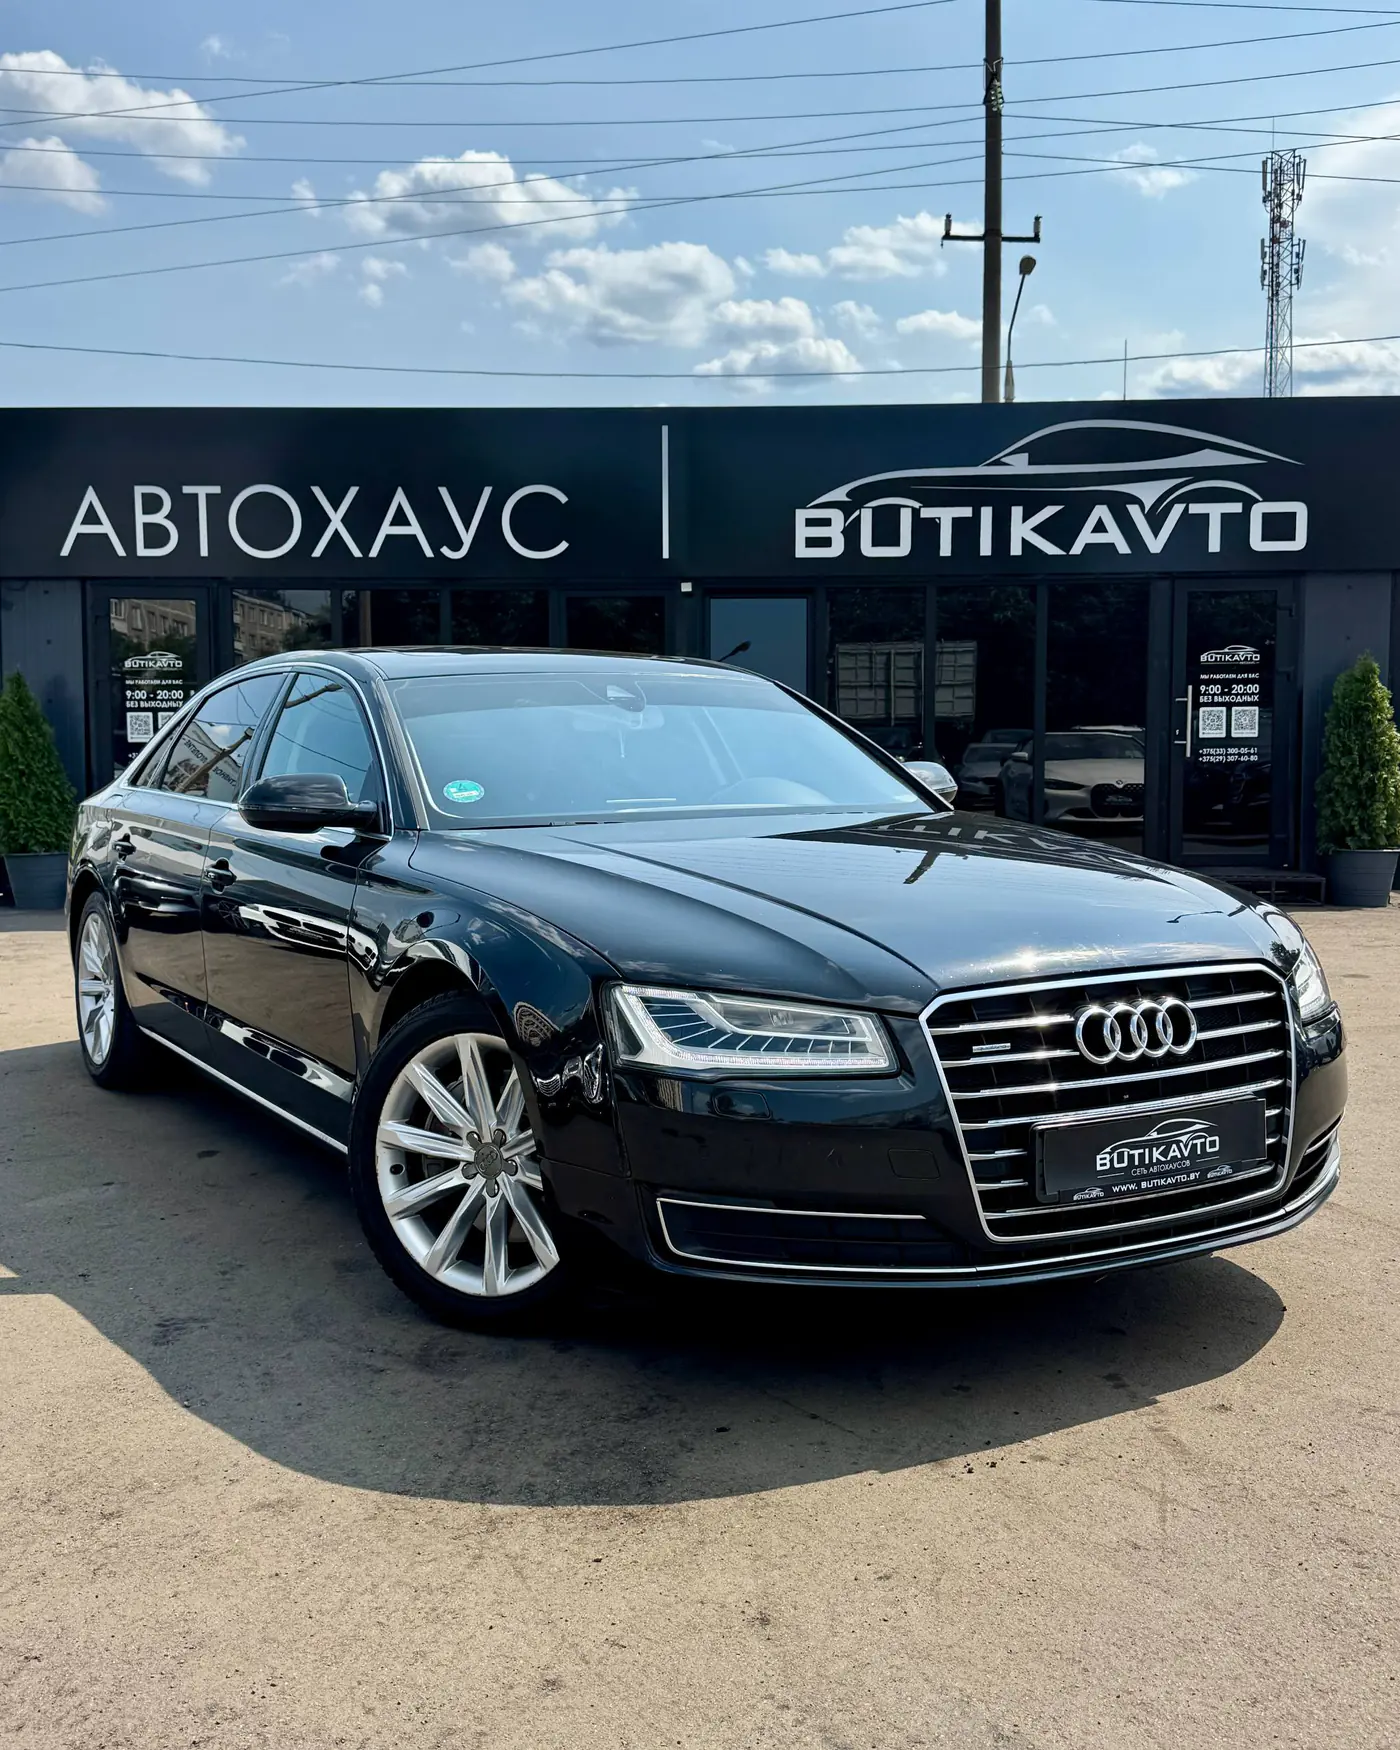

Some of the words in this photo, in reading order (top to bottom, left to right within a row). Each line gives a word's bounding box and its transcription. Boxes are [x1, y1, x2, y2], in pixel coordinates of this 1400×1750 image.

[60, 484, 570, 559] АВТОХАУС
[795, 501, 1308, 558] BUTIKAVTO
[1200, 654, 1260, 662] BUTIKAVTO
[124, 660, 183, 668] BUTIKAVTO
[1200, 684, 1221, 694] 9:00
[1231, 684, 1260, 694] 20:00
[125, 690, 147, 700] 9:00
[156, 690, 184, 700] 20:00
[1214, 695, 1260, 703] ВЫХОДНЫХ
[1198, 755, 1226, 763] +375(29)
[1096, 1136, 1220, 1170] BUTIKAVTO
[1131, 1168, 1148, 1177] СЕТЬ
[1149, 1160, 1191, 1174] АВТОХАУСОВ
[1112, 1183, 1139, 1193] WWW.
[1141, 1172, 1201, 1189] BUTIKAVTO.BY
